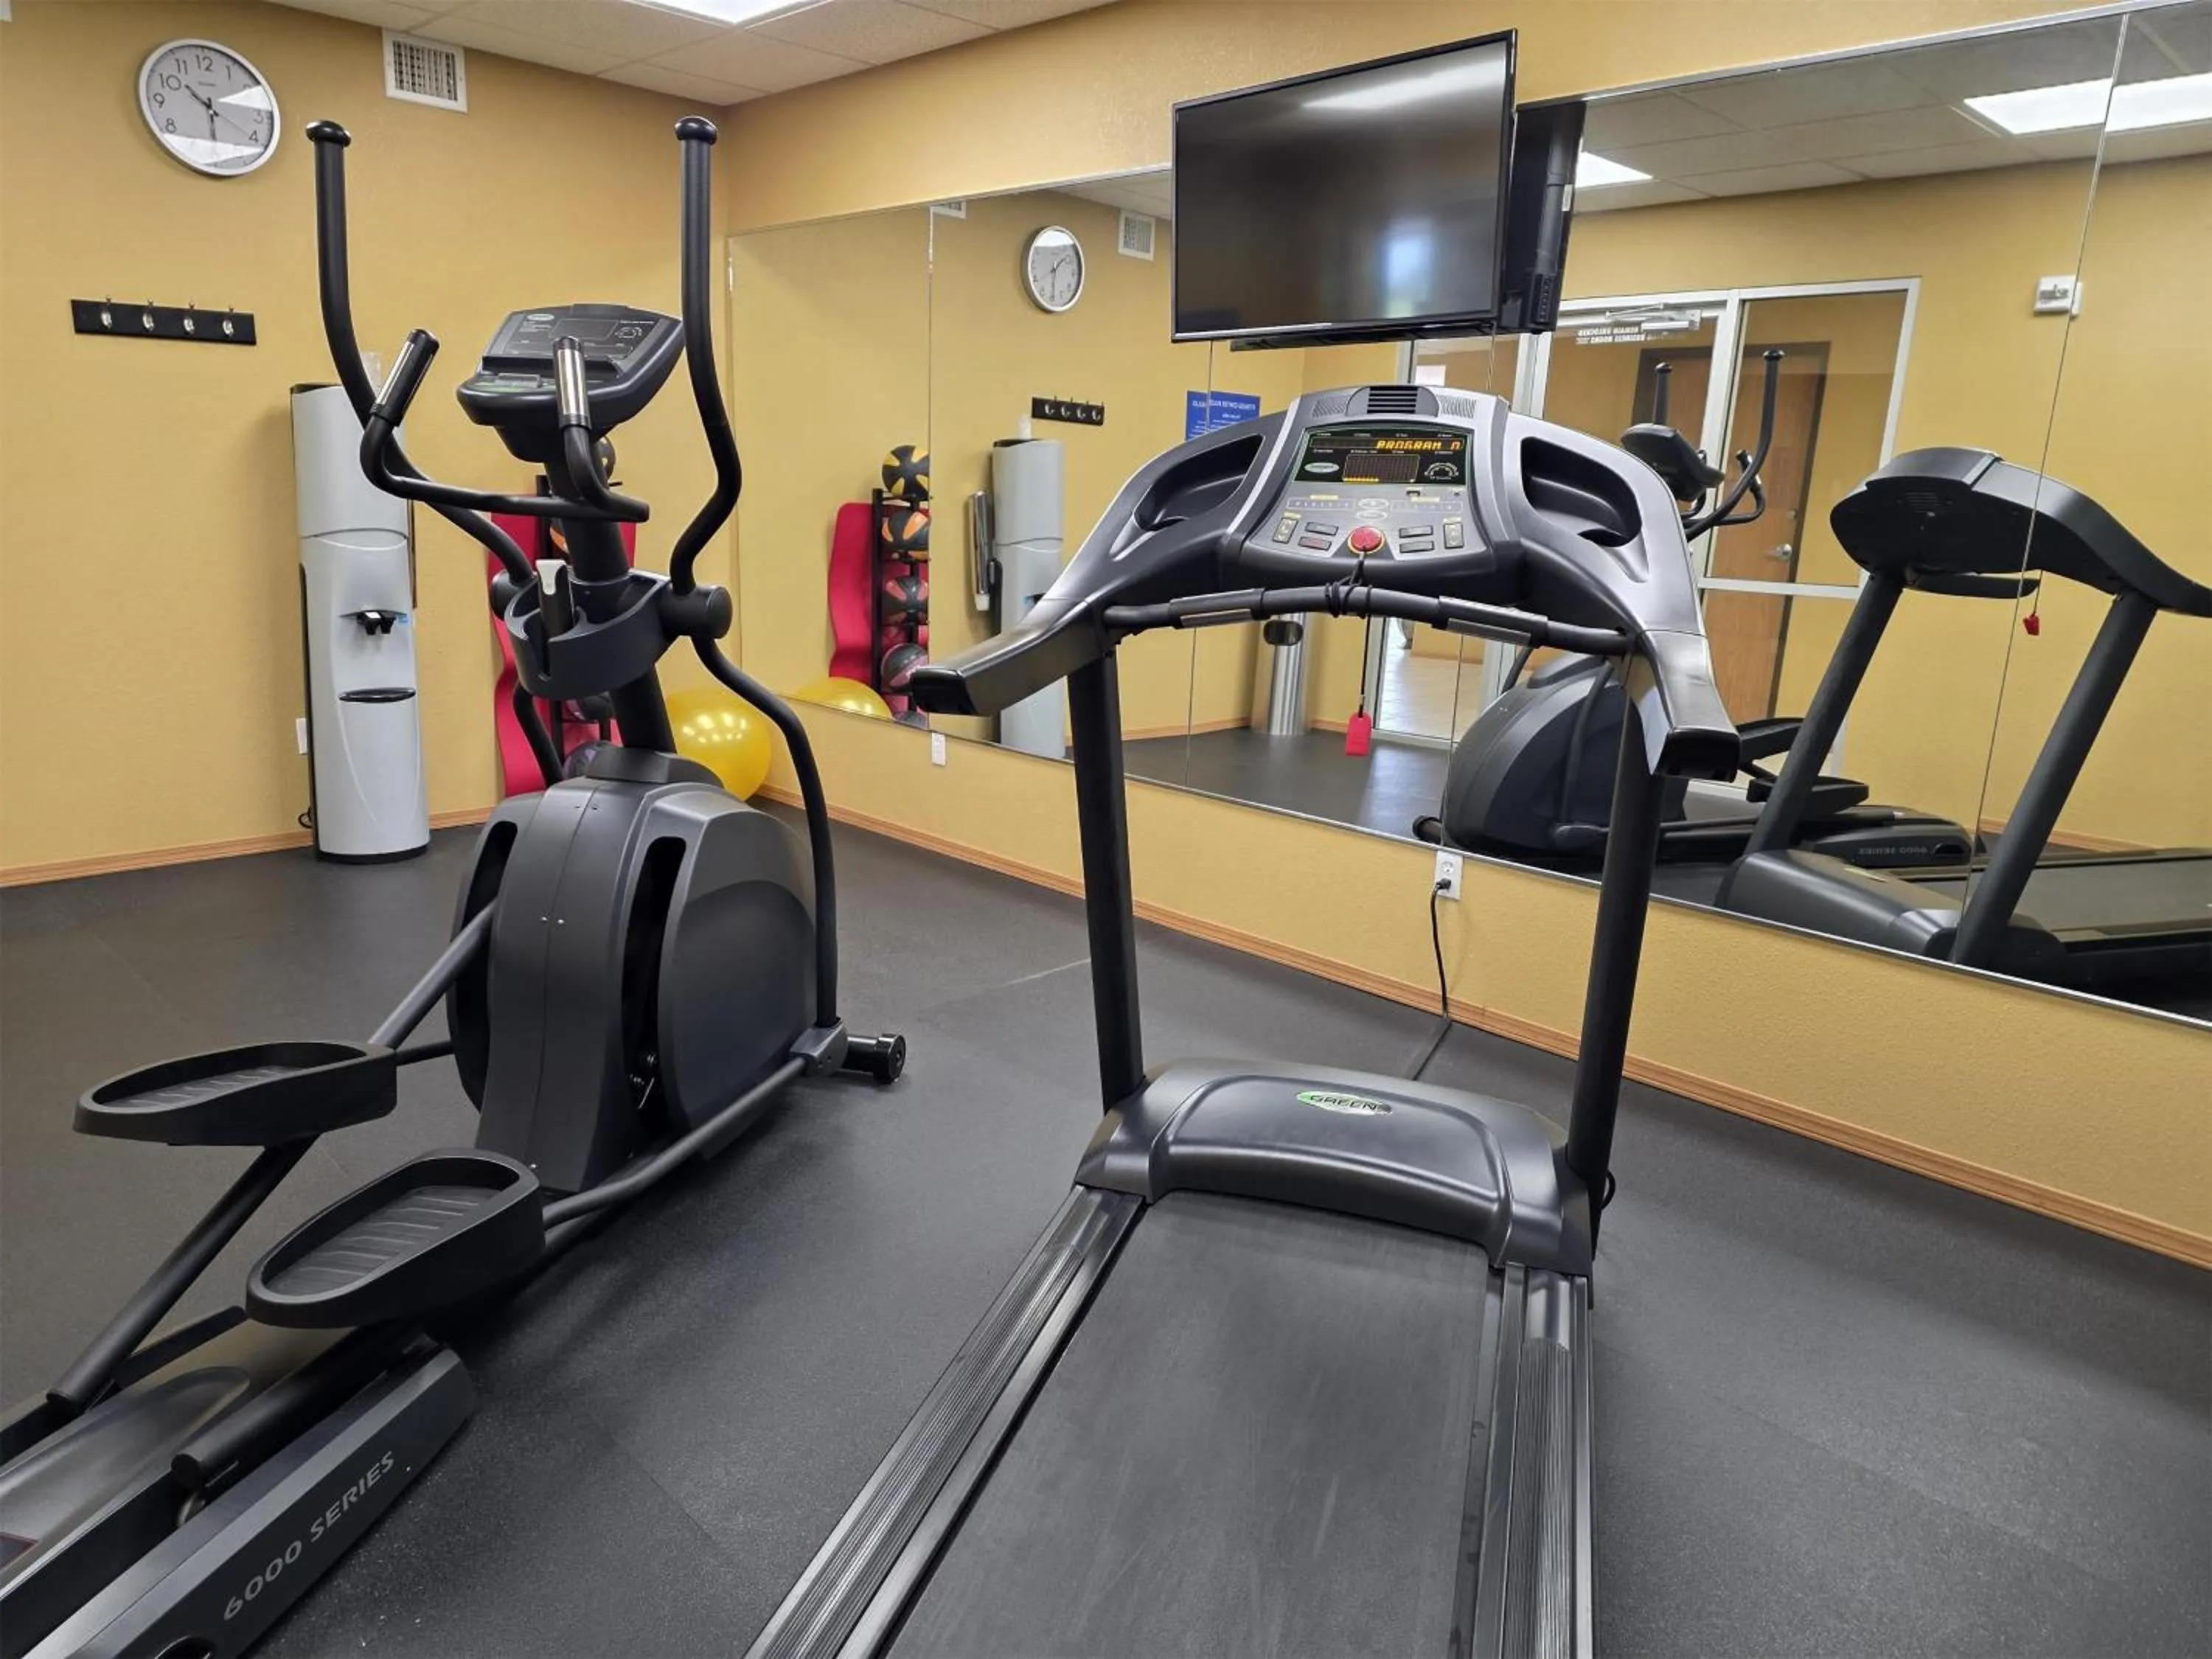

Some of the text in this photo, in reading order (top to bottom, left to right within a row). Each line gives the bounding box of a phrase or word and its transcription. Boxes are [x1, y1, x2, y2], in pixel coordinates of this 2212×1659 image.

[175, 58, 188, 75] 11
[195, 54, 213, 72] 12
[226, 65, 232, 80] 1
[159, 73, 181, 91] 10
[153, 92, 165, 108] 9
[253, 110, 264, 125] 3
[164, 118, 177, 133] 8
[248, 130, 259, 143] 4
[1377, 440, 1441, 450] PROGRAM
[223, 1450, 394, 1621] 6000 SERIES
